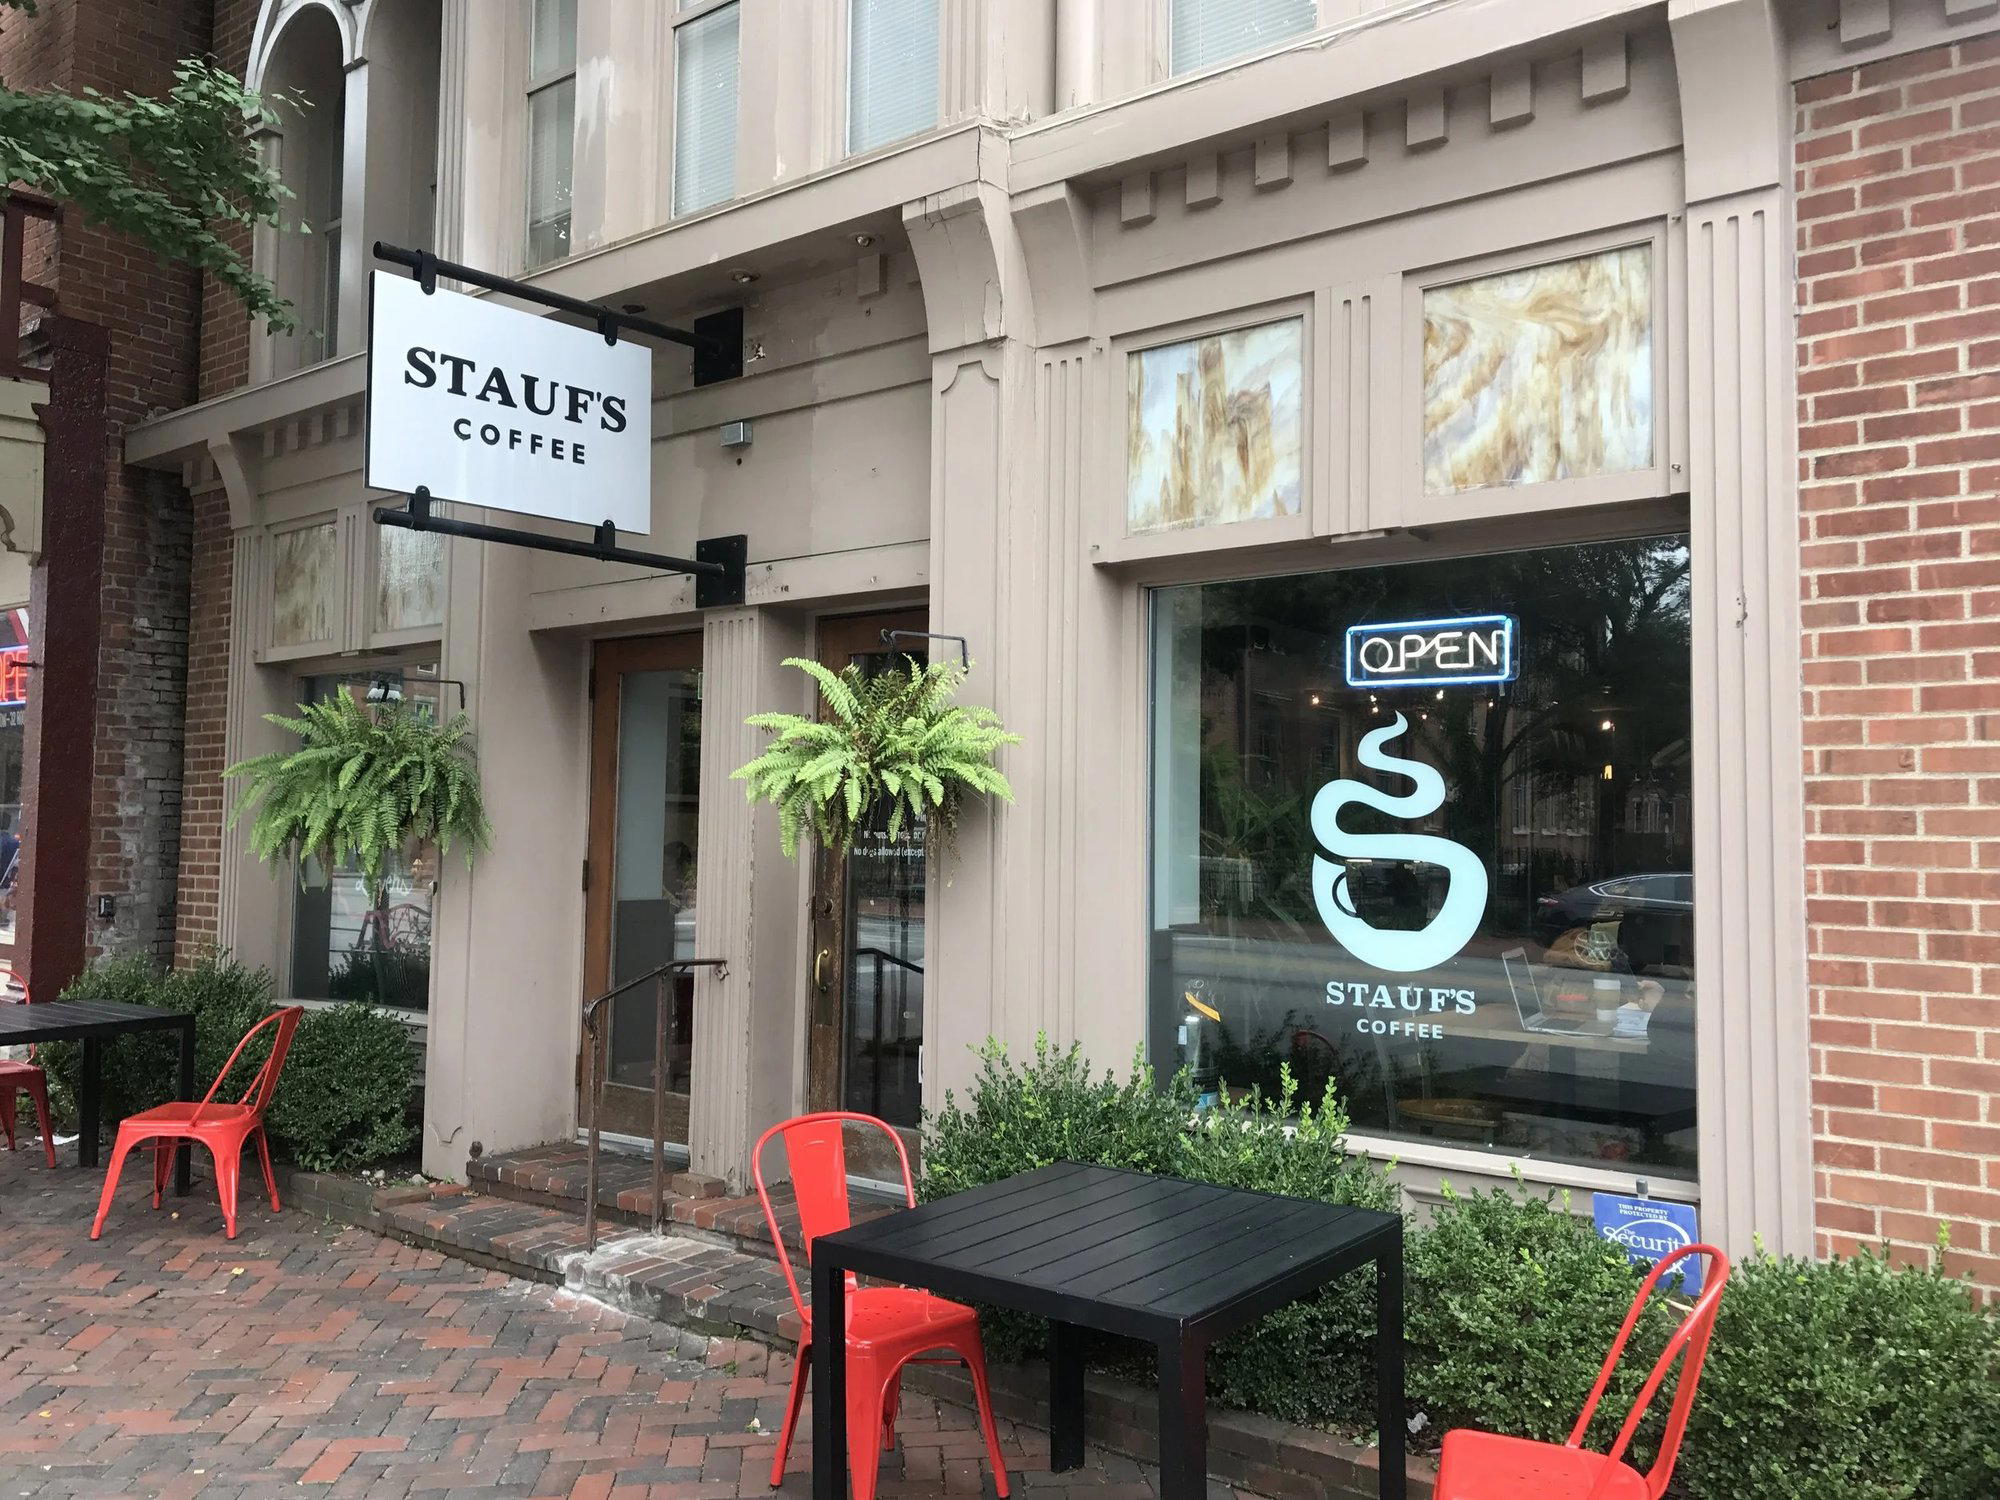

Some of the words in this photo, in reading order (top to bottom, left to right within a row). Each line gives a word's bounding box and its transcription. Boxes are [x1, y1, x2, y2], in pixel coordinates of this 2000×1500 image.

[404, 346, 627, 432] STAUF'S
[453, 417, 585, 464] COFFEE
[1359, 629, 1506, 672] OPEN
[853, 847, 862, 856] No
[1326, 981, 1476, 1015] STAUF'S
[1356, 1018, 1444, 1039] COFFEE
[1619, 1209, 1660, 1219] PROTECTED
[1634, 1205, 1669, 1215] PROPERTY
[1602, 1226, 1686, 1254] Securit
